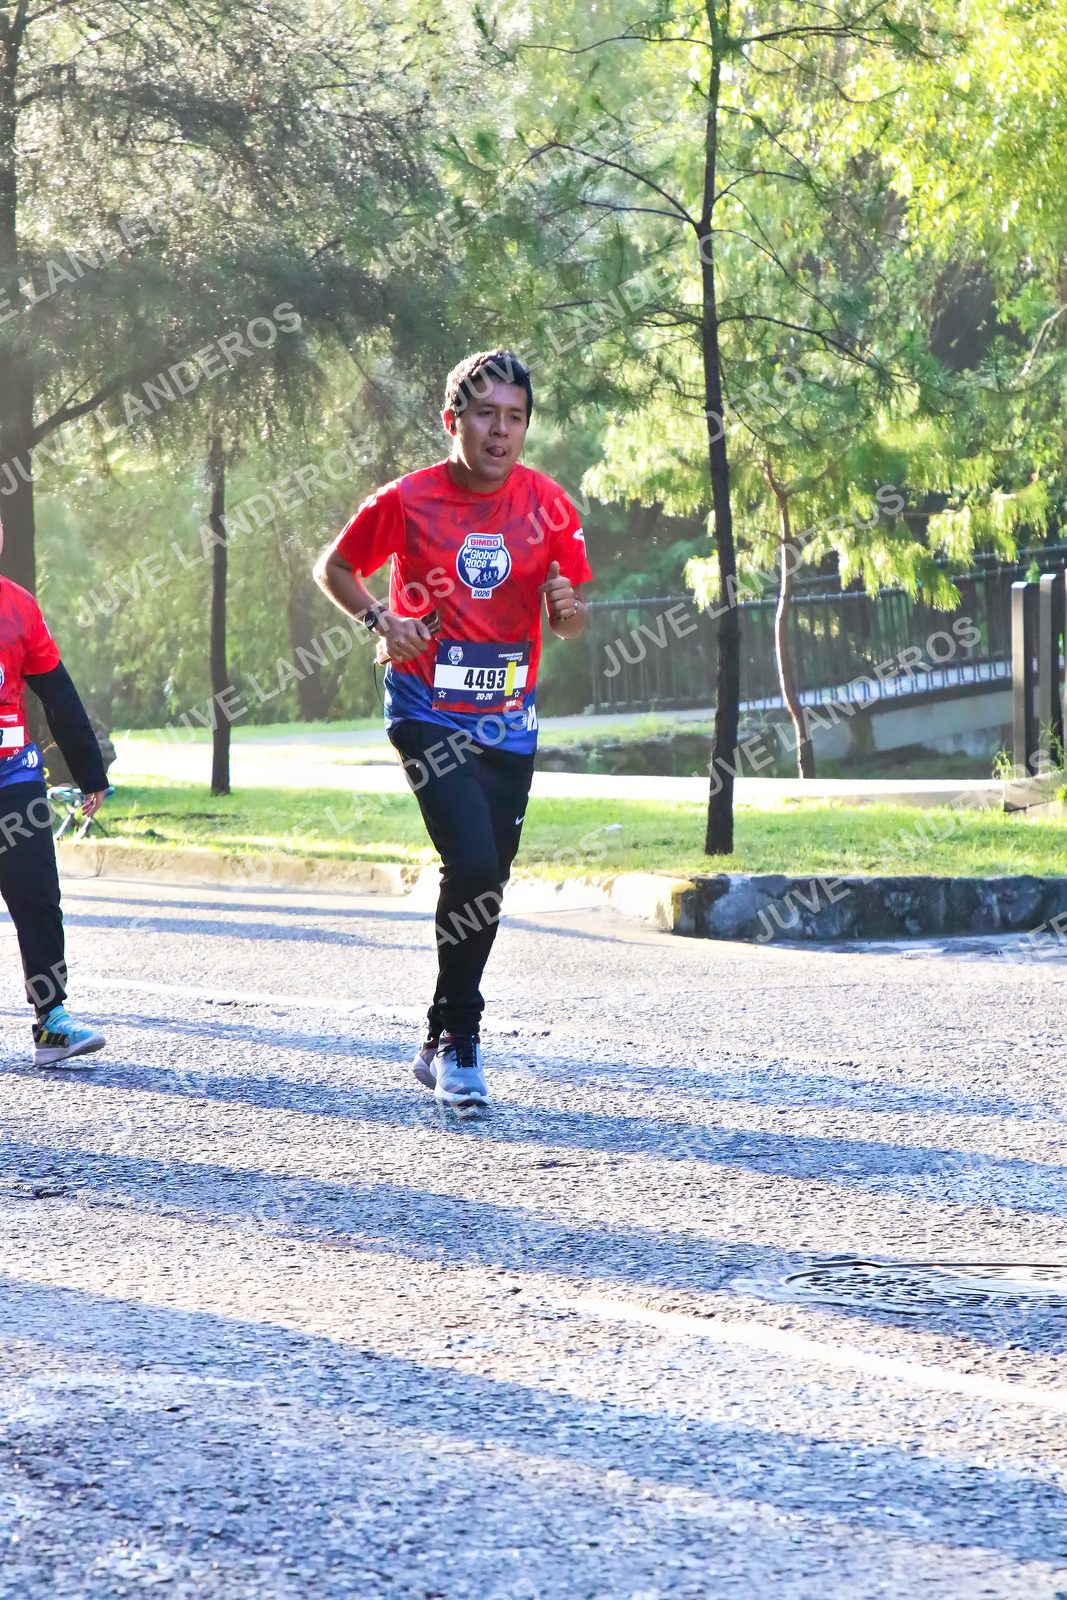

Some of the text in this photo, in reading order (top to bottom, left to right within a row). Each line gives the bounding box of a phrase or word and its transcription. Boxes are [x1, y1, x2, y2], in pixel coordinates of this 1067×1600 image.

[470, 539, 499, 547] BIMBO
[470, 549, 498, 560] Global
[464, 558, 487, 568] Race
[463, 668, 507, 689] 4493
